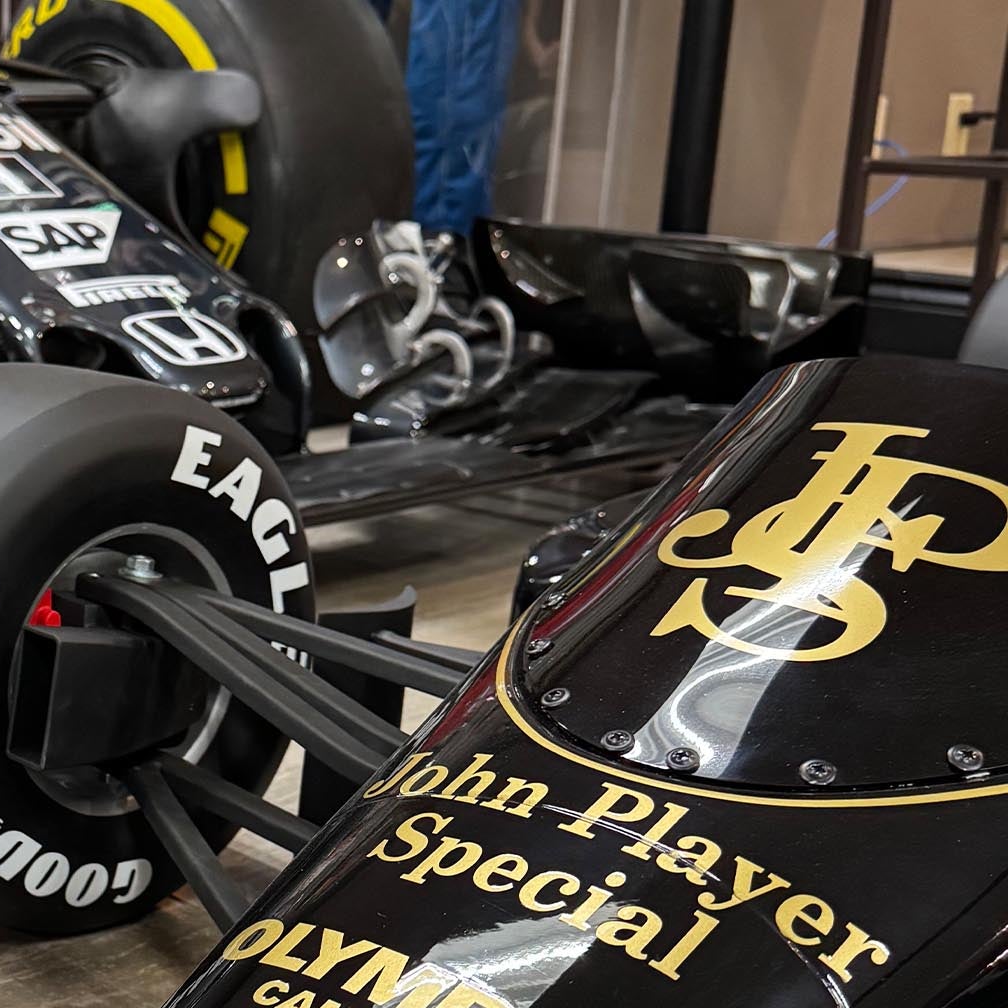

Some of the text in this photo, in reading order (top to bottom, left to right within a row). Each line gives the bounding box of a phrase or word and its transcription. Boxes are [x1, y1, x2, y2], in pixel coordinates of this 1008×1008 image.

[1, 222, 107, 255] SAP
[363, 751, 892, 984] John Player
[366, 812, 721, 981] Special
